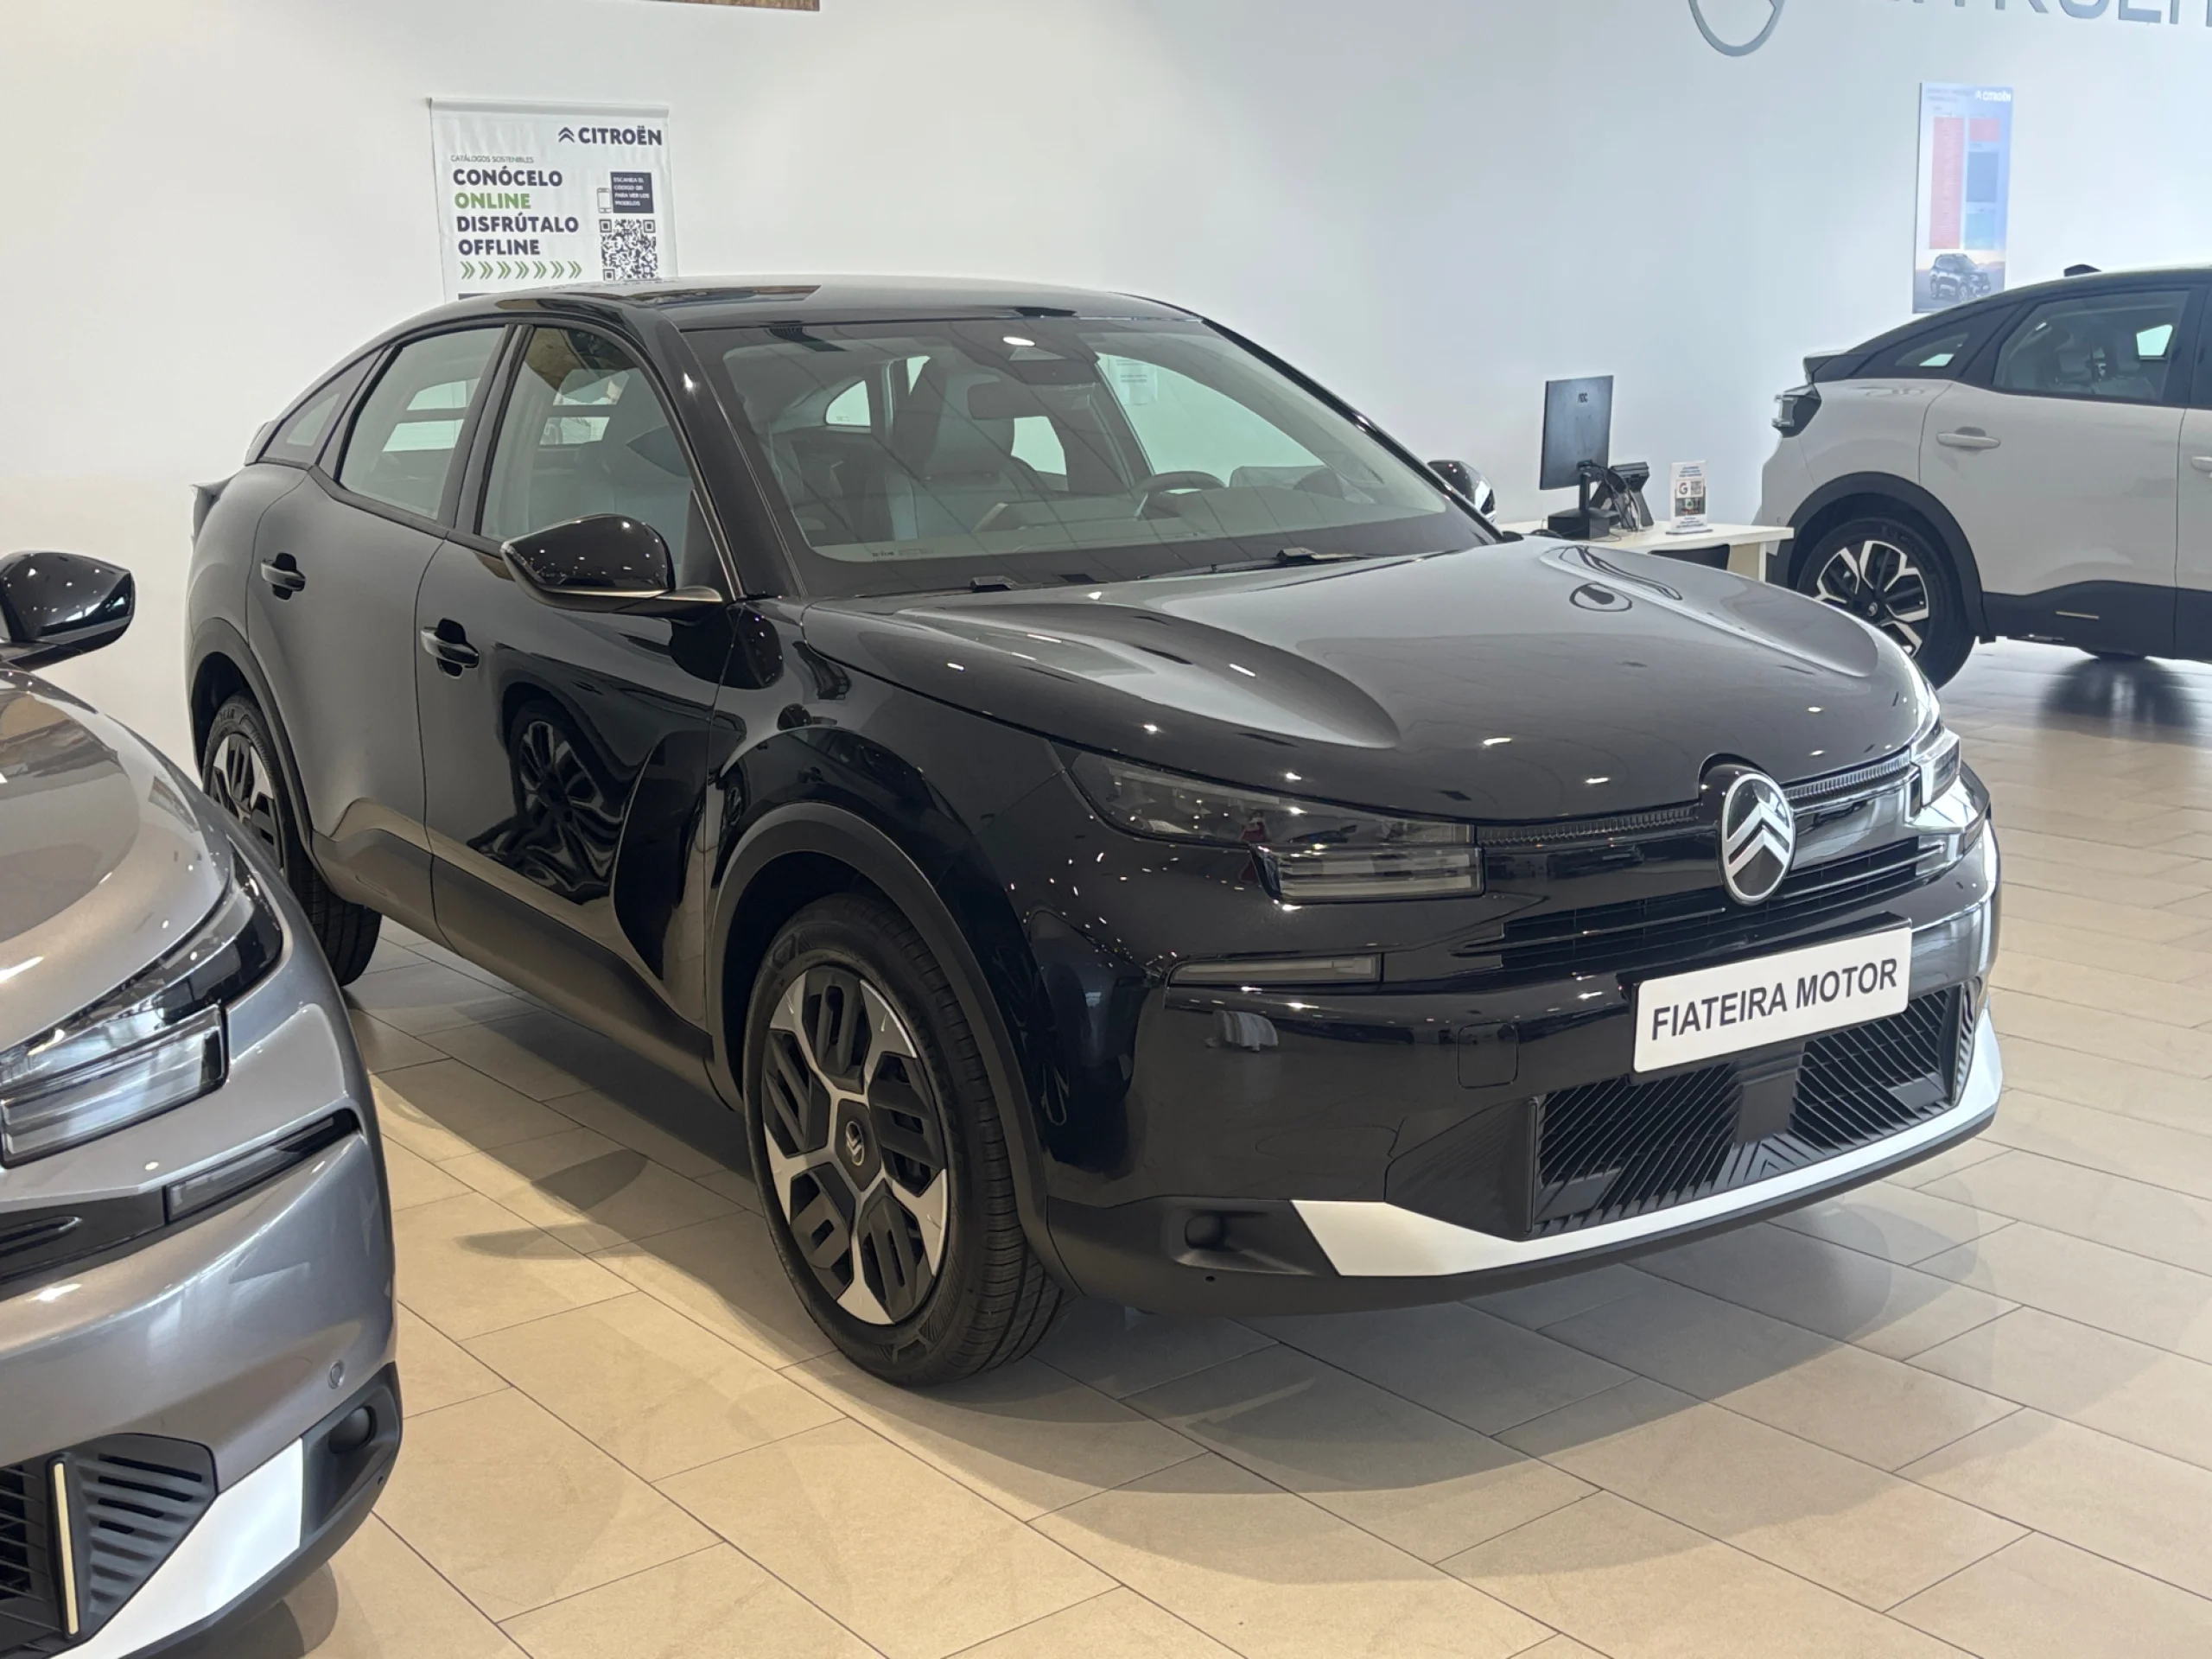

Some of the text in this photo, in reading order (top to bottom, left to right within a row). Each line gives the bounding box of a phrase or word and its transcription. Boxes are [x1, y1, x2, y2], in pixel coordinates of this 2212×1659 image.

[578, 125, 662, 146] CITROËN
[453, 166, 563, 188] CONÓCELO
[454, 192, 532, 210] ONLINE
[456, 213, 580, 233] DISFRÚTALO
[458, 238, 541, 256] OFFLINE
[1651, 957, 1897, 1041] FIATEIRA MOTOR
